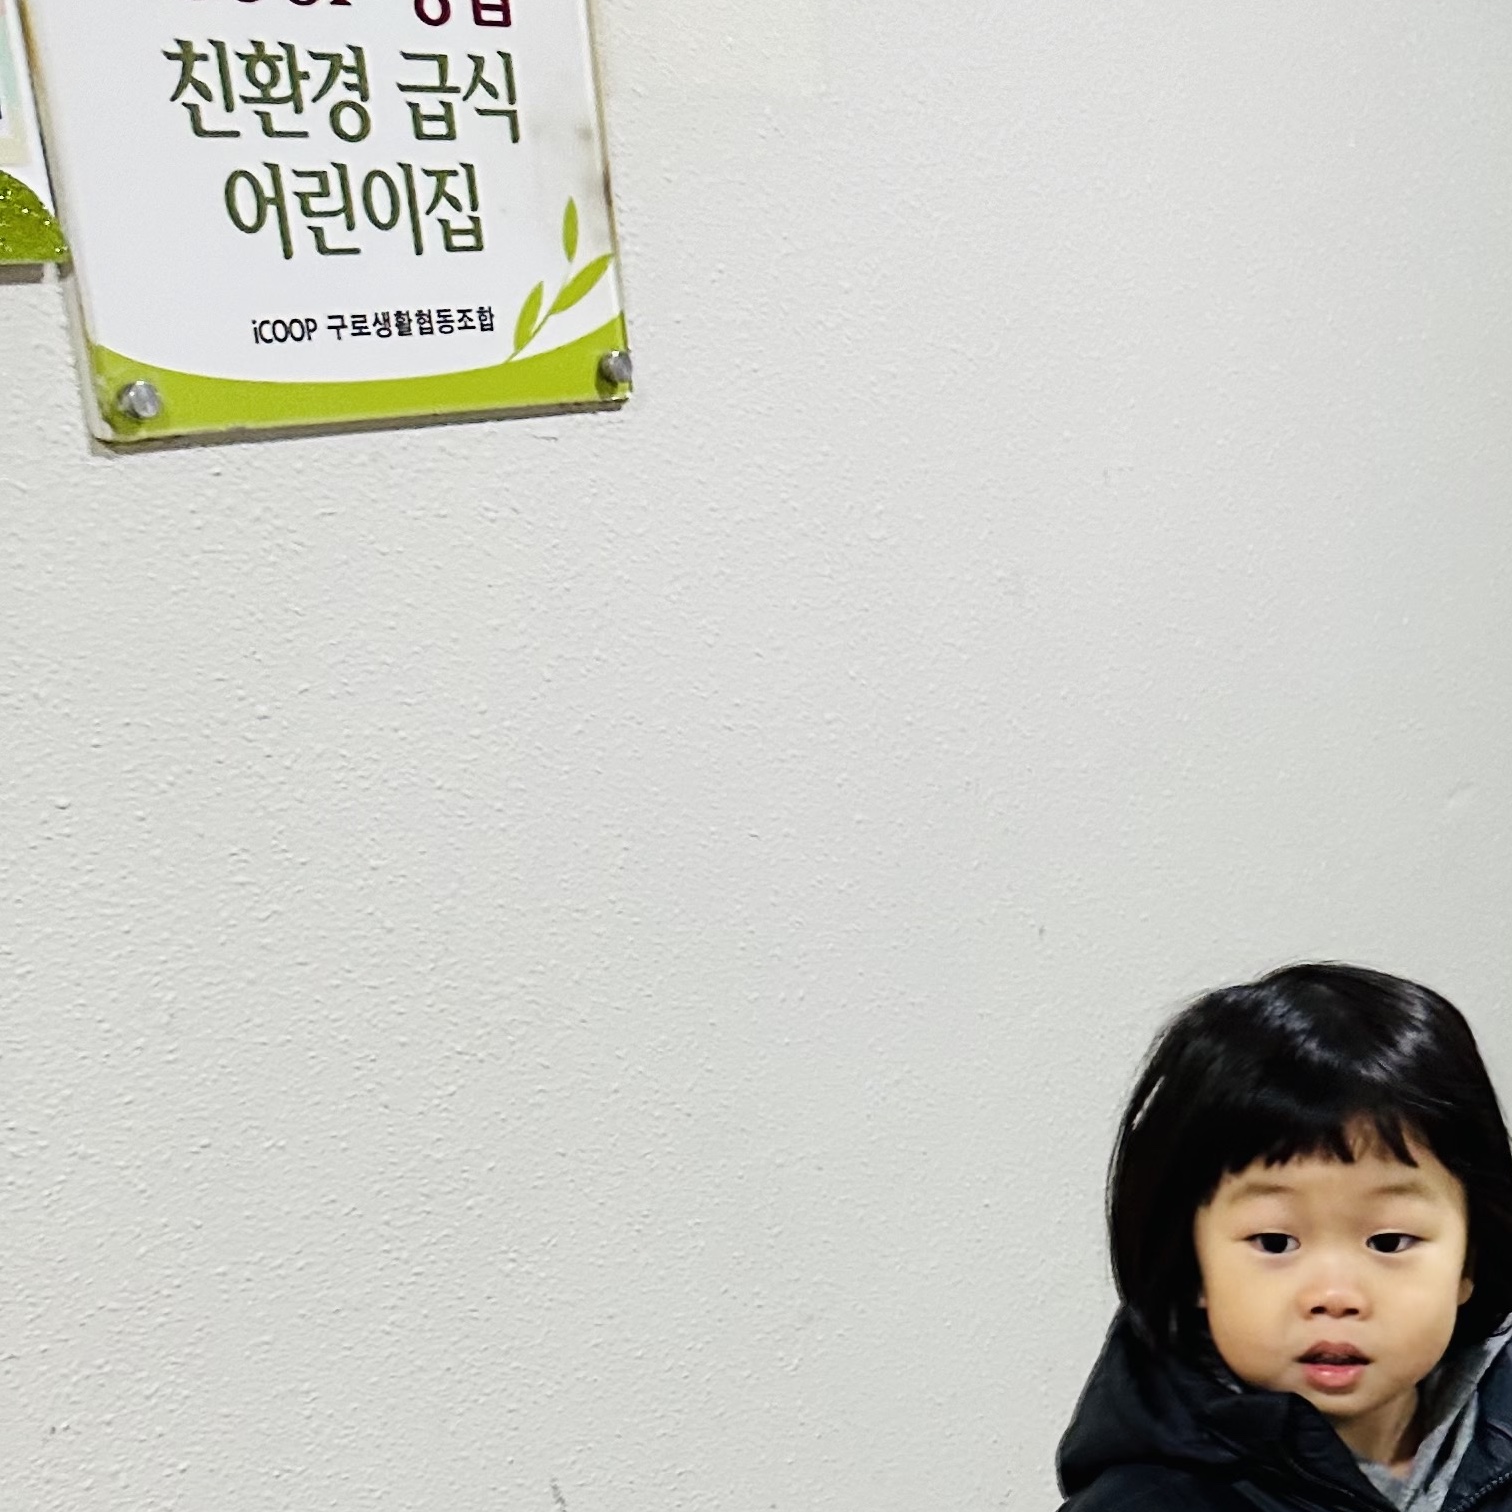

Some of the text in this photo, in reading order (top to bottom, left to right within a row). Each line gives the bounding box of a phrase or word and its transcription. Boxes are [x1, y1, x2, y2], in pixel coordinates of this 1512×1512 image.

[162, 38, 520, 144] 친환경 급식
[224, 161, 486, 260] 어린이집
[251, 305, 496, 345] iCOOP 구로생활협동조합
